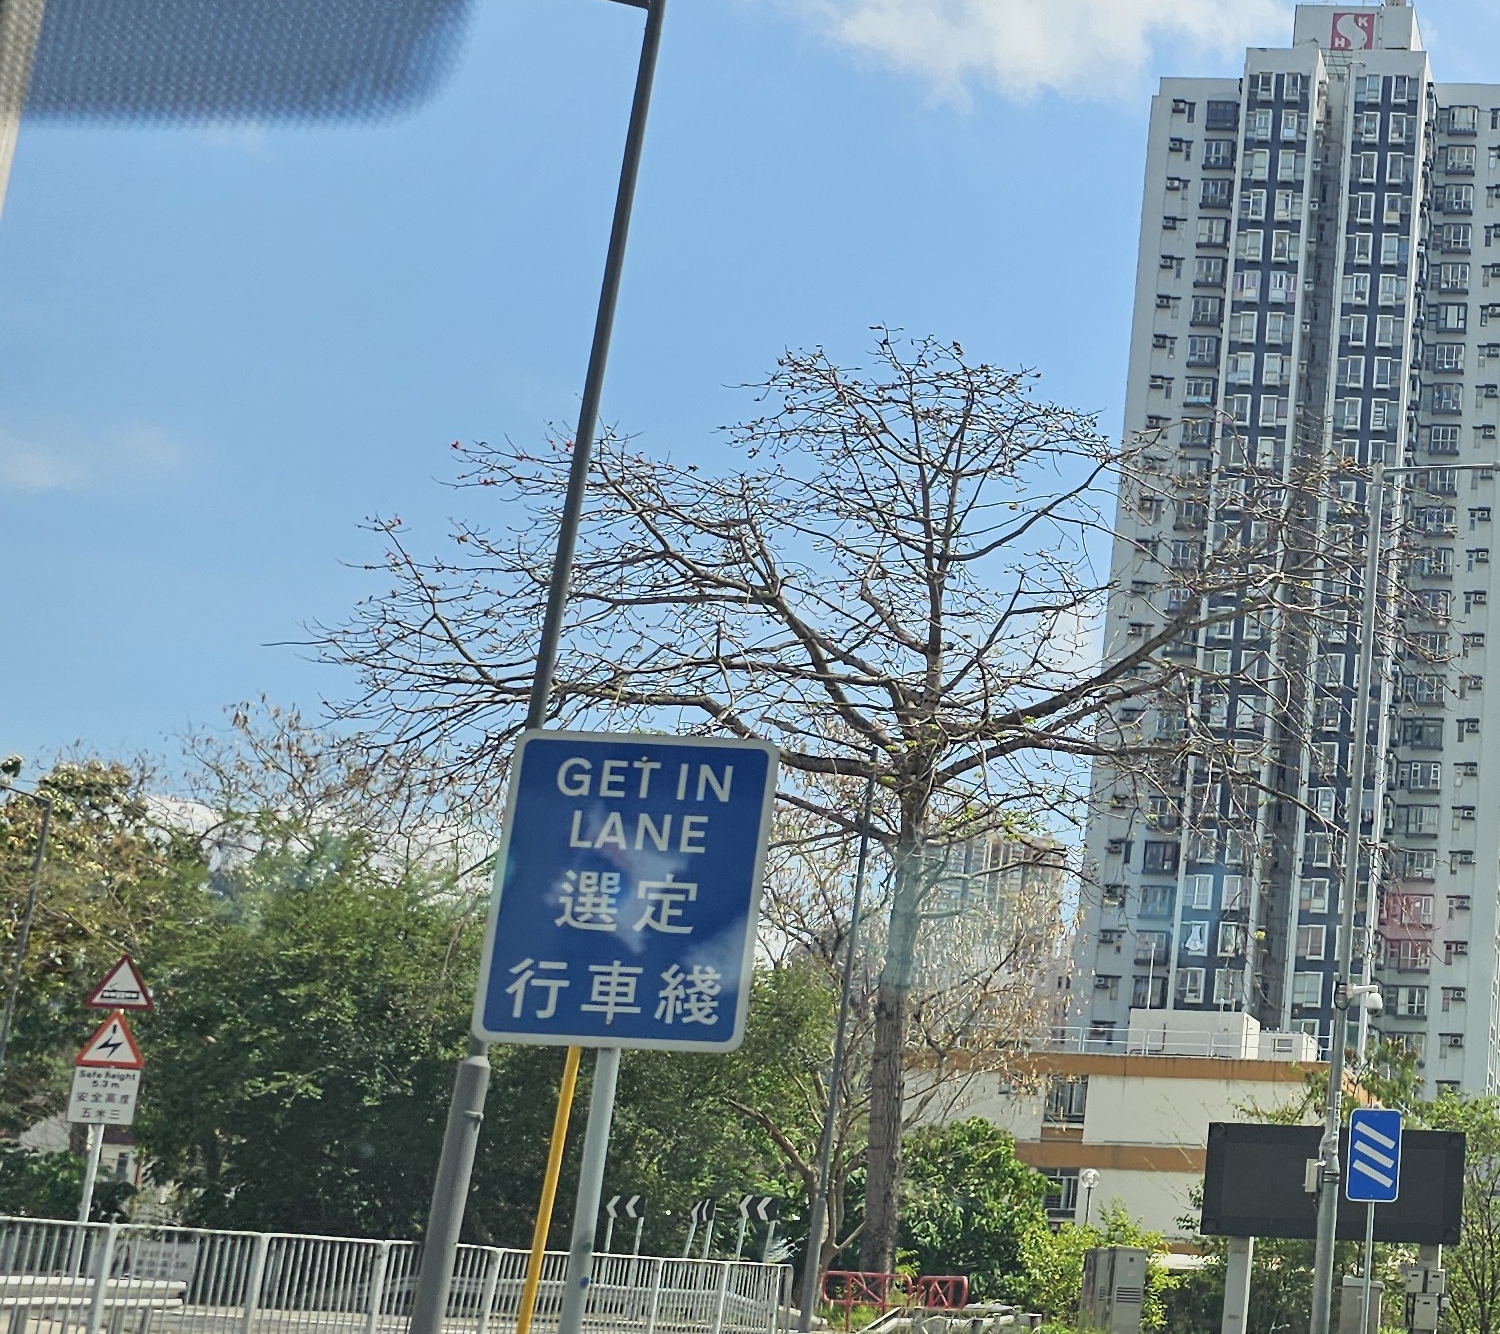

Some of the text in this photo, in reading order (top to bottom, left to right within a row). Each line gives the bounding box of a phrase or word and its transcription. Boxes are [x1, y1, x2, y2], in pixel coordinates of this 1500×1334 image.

[556, 757, 734, 803] GET IN
[569, 810, 709, 854] LANE
[554, 870, 698, 934] 選定
[505, 957, 722, 1025] 行車綫
[79, 1070, 136, 1082] Safe height
[80, 1107, 121, 1121] 五米三
